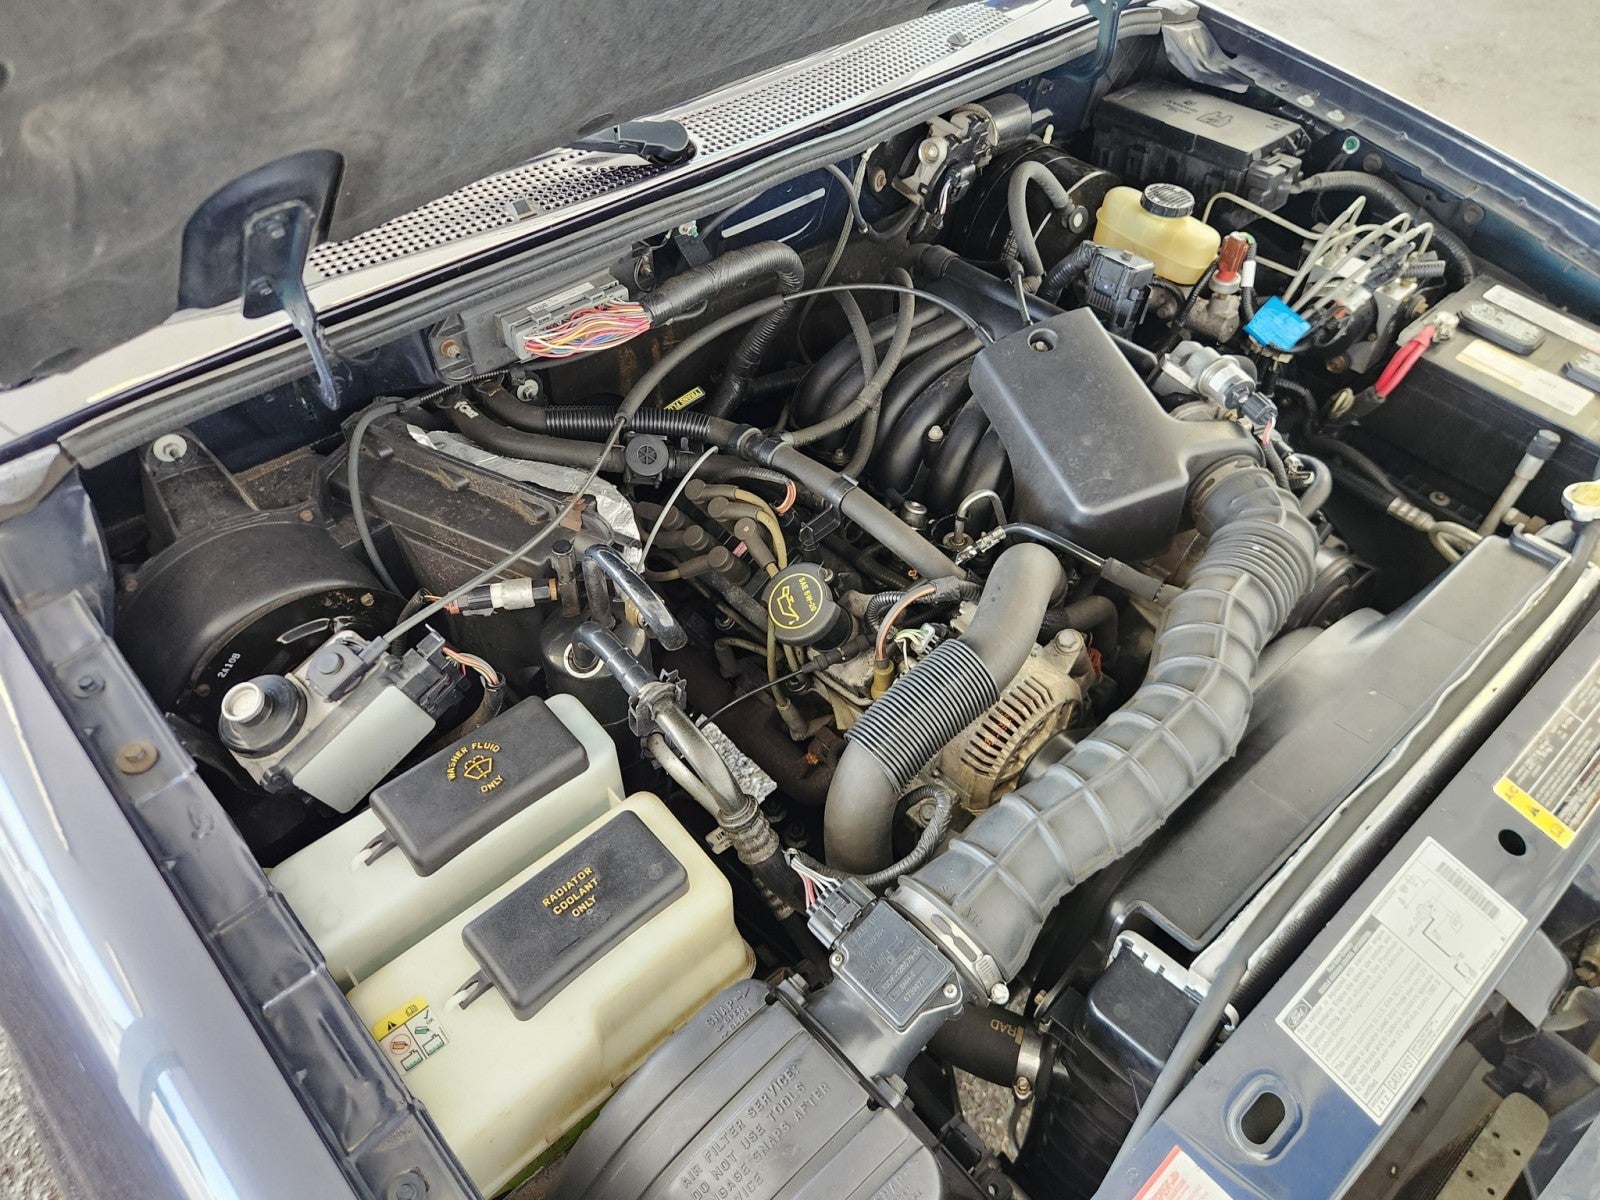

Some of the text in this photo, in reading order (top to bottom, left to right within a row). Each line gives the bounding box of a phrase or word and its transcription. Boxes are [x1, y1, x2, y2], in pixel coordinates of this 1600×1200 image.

[799, 577, 809, 591] SAE
[447, 742, 501, 781] WASHER FLUID
[480, 774, 504, 793] ONLY
[542, 866, 593, 908] RADIATOR
[552, 877, 599, 916] COOLANT
[571, 894, 598, 918] ONLY
[990, 1018, 1017, 1036] RAD
[1388, 1054, 1415, 1091] CATALYST
[678, 1062, 801, 1189] AIR FILTER SERVICE:
[690, 1079, 809, 1200] DO NOT USE TOOLS
[749, 1117, 793, 1163] SNAPS
[789, 1079, 832, 1123] AFTER
